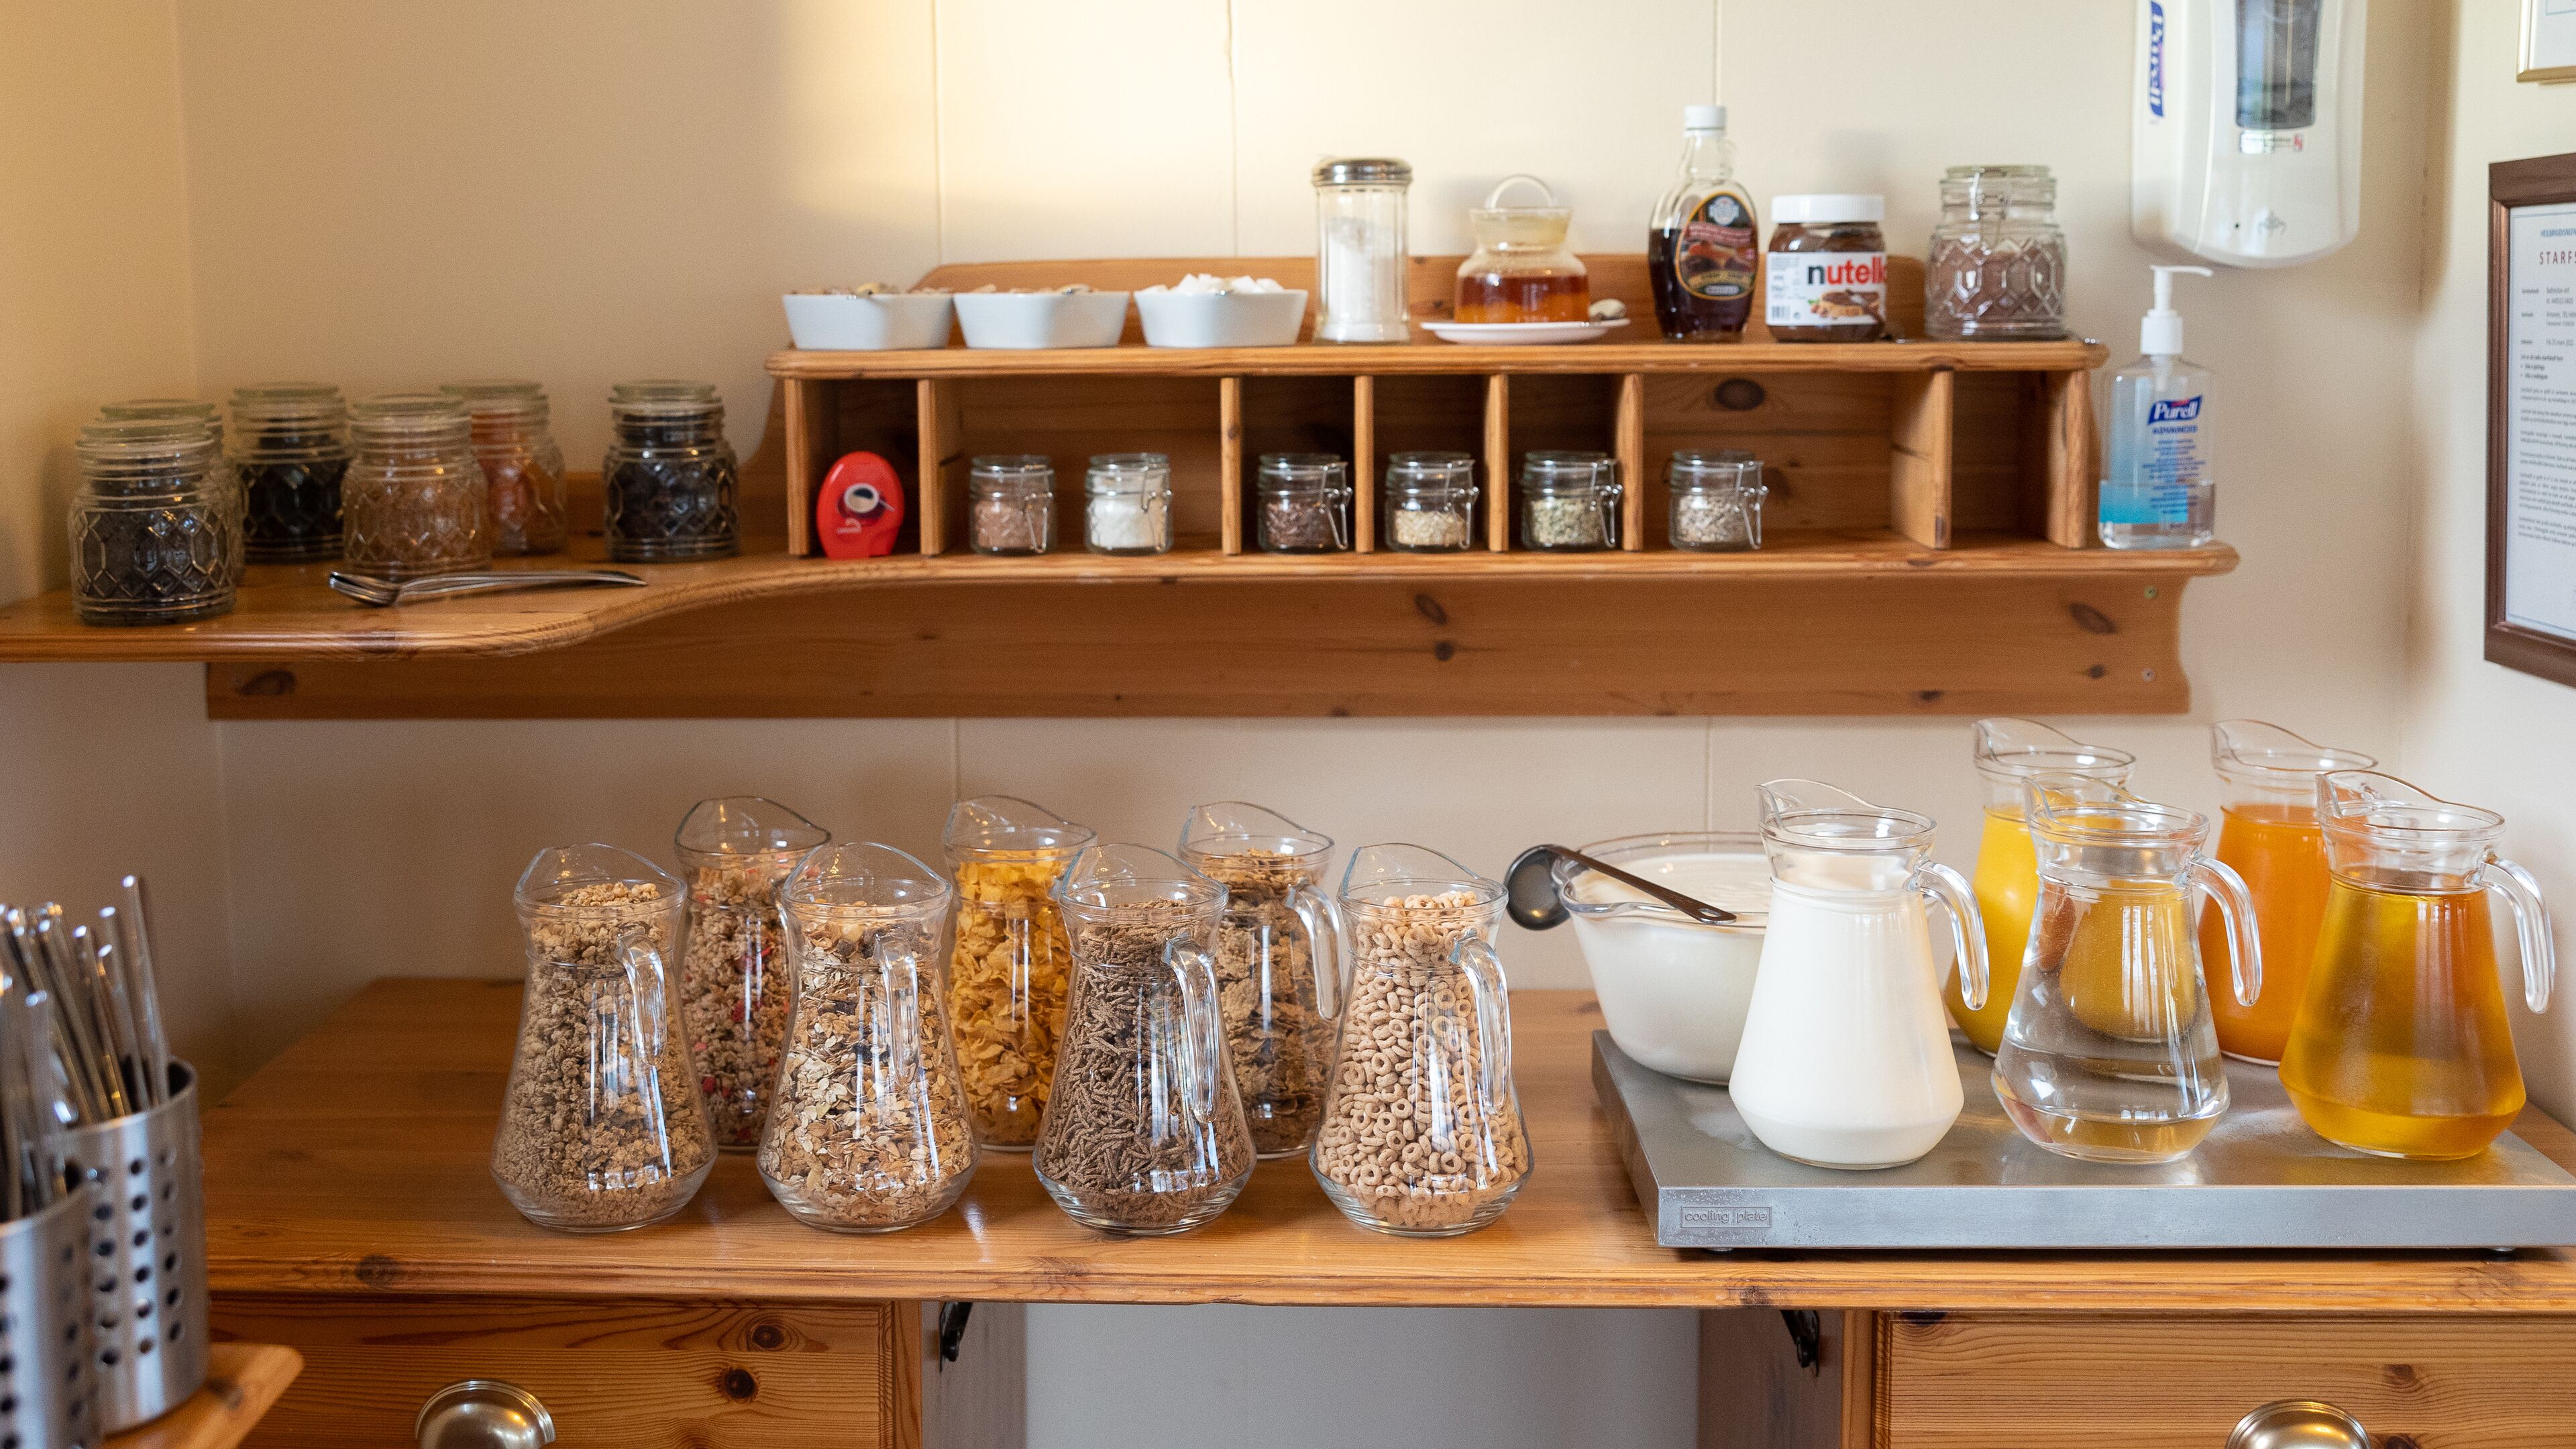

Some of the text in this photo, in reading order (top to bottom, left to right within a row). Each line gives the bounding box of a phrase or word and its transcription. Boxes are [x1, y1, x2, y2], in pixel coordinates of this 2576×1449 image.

[2153, 400, 2198, 420] Purell
[1684, 1210, 1768, 1223] cooling plate
